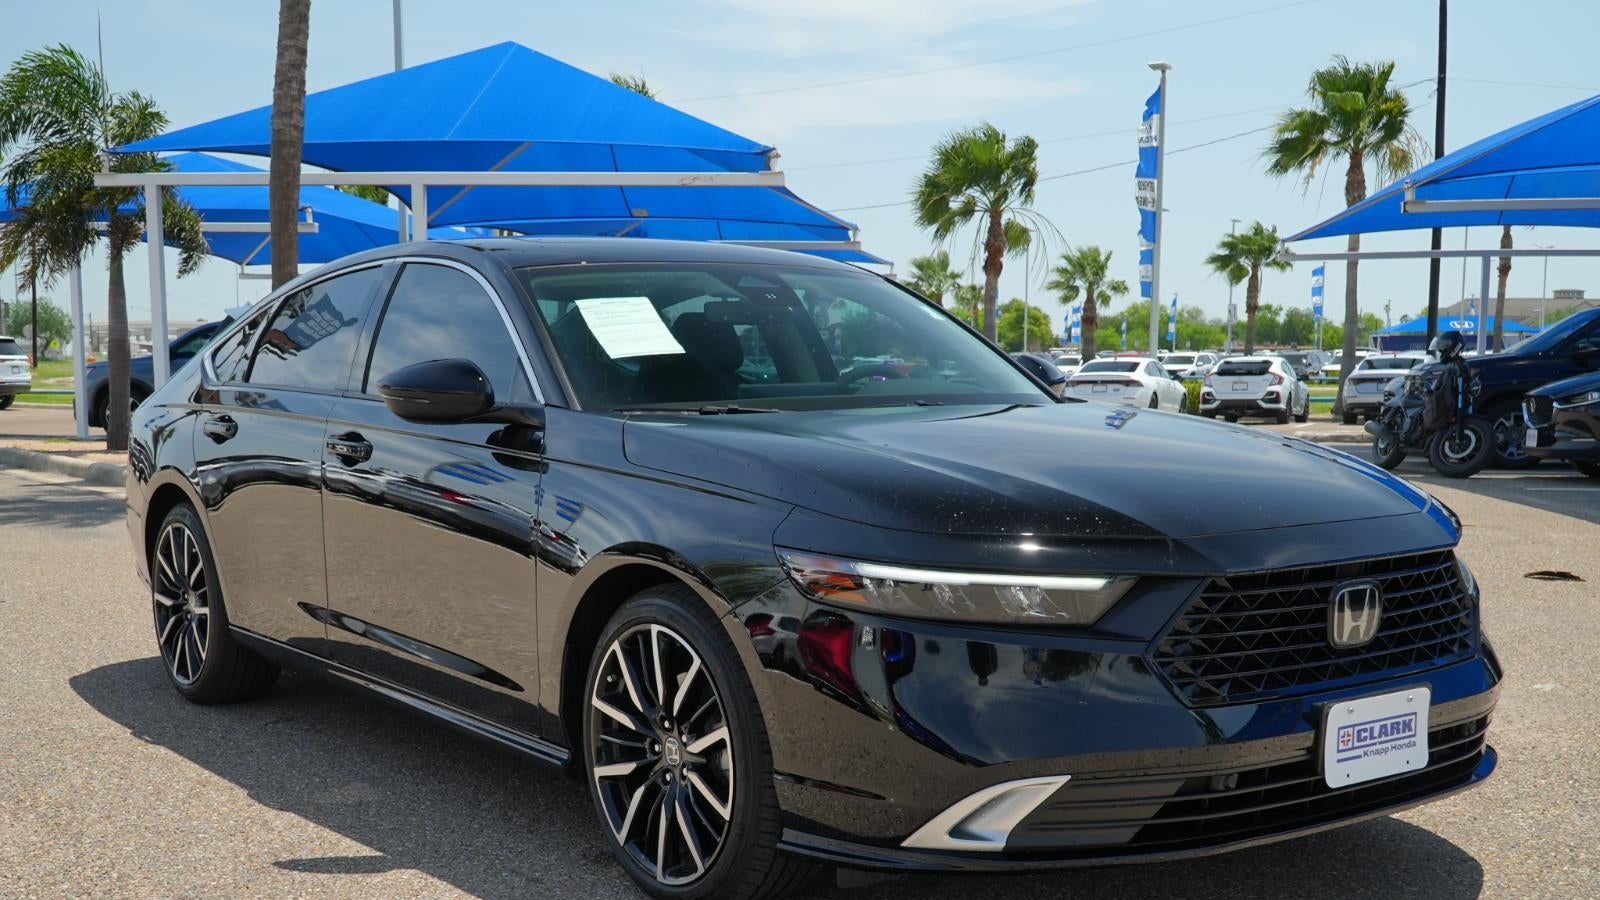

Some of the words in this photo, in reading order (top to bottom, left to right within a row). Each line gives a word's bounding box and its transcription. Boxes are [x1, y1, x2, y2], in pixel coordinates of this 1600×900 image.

[1356, 718, 1414, 743] CLARK
[1363, 746, 1389, 758] Knapp
[1390, 740, 1417, 752] Honda
